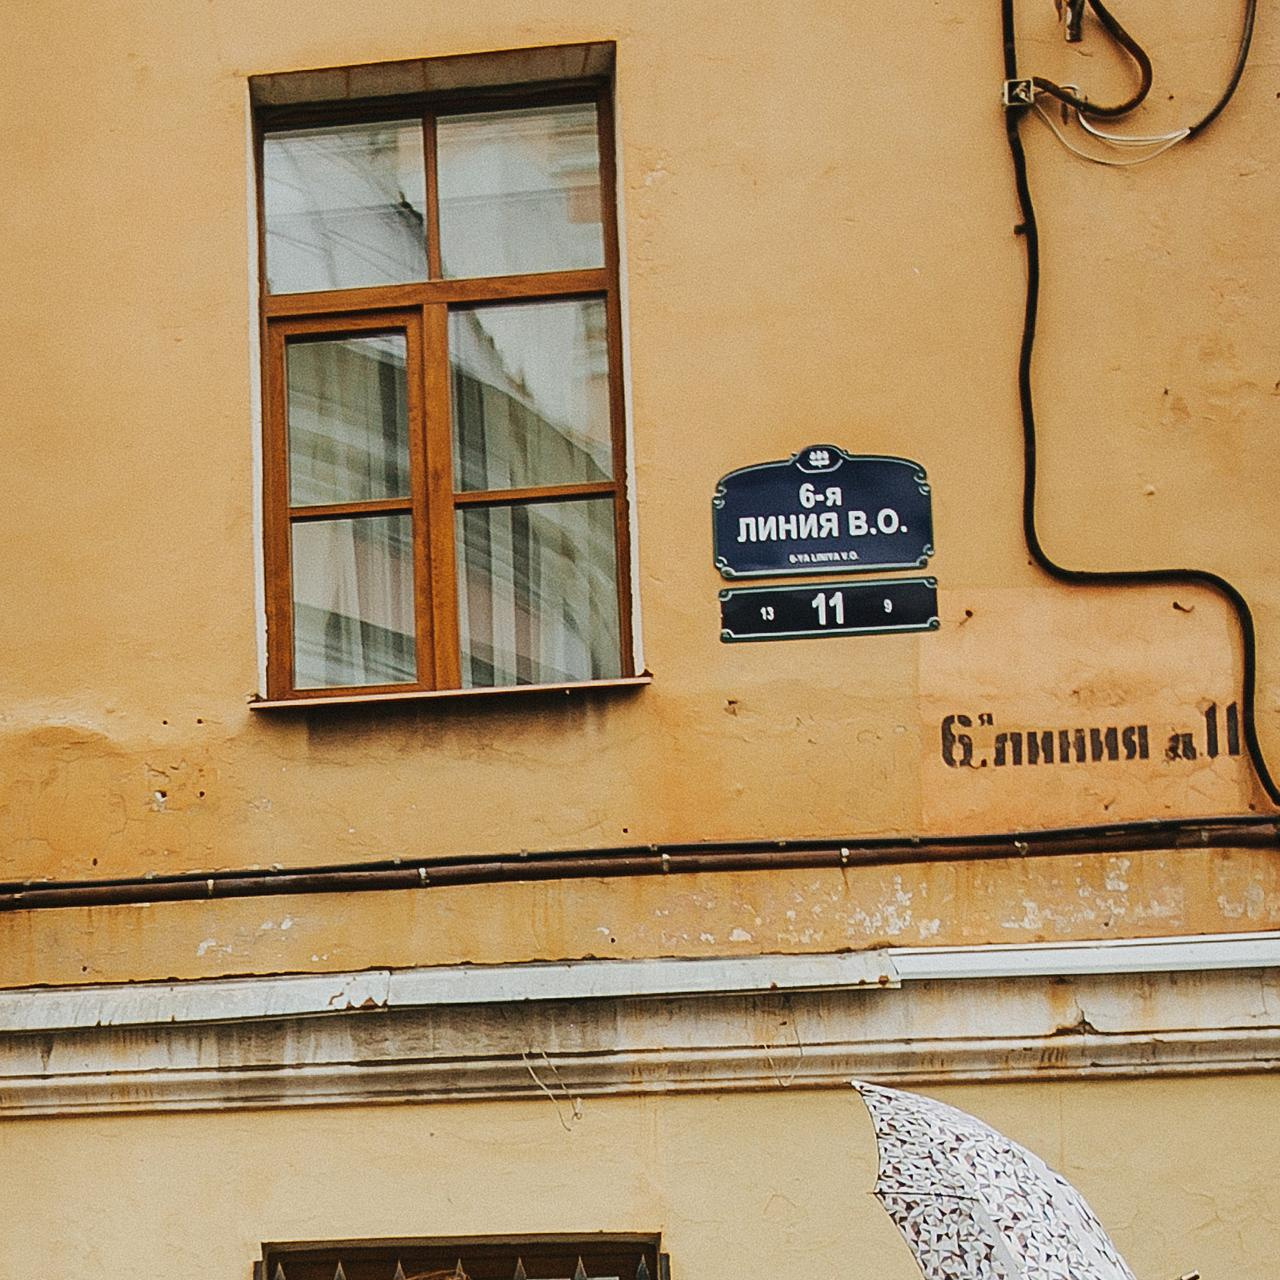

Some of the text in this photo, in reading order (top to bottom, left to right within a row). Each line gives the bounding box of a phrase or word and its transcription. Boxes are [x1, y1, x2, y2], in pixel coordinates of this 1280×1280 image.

[799, 483, 842, 508] 6-я
[737, 508, 908, 542] ЛИНИЯ В.О.
[760, 592, 892, 625] 13 11 9
